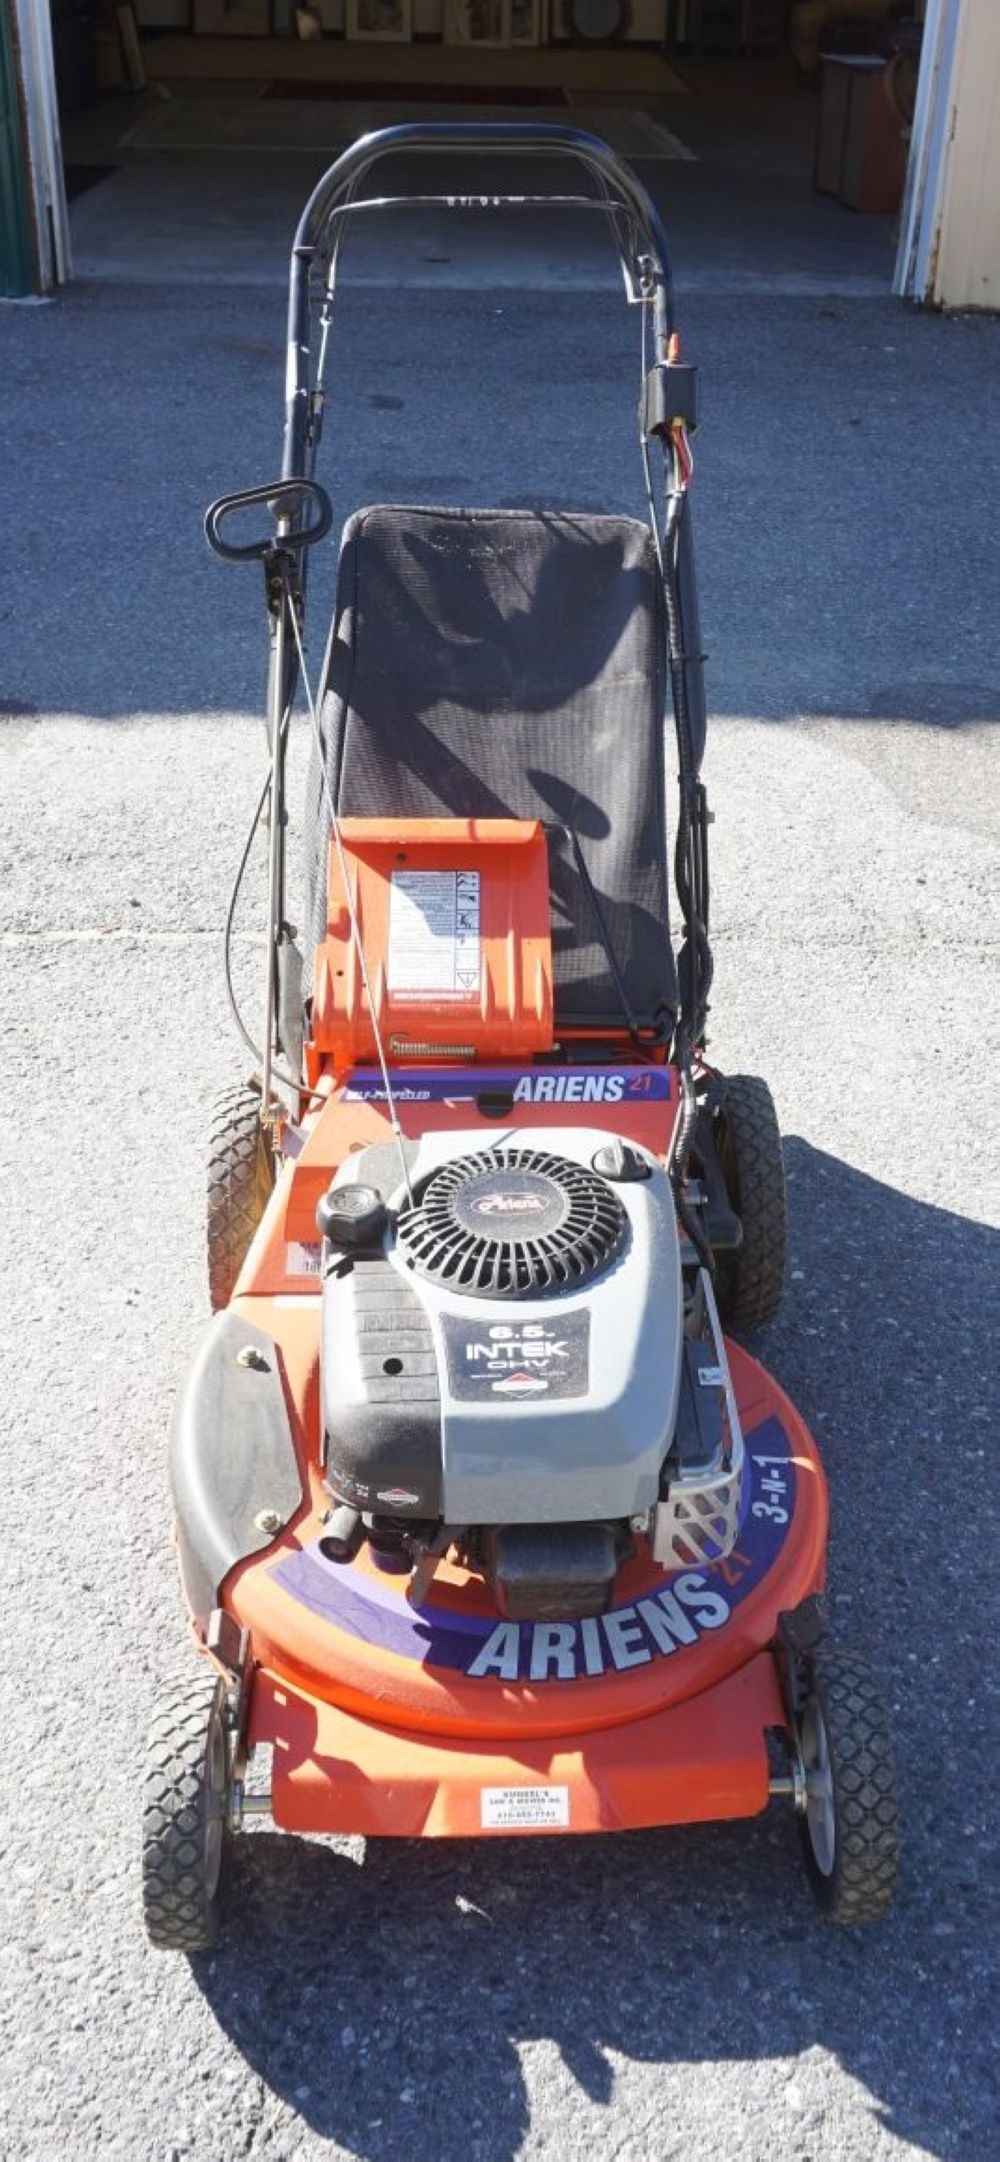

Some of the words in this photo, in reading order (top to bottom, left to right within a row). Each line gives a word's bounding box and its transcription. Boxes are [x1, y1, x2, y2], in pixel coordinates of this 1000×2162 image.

[513, 1075, 625, 1102] ARIENS
[630, 1077, 652, 1091] 21
[466, 1341, 570, 1360] INTEK
[487, 1360, 550, 1369] OHV
[466, 1573, 730, 1681] ARIENS
